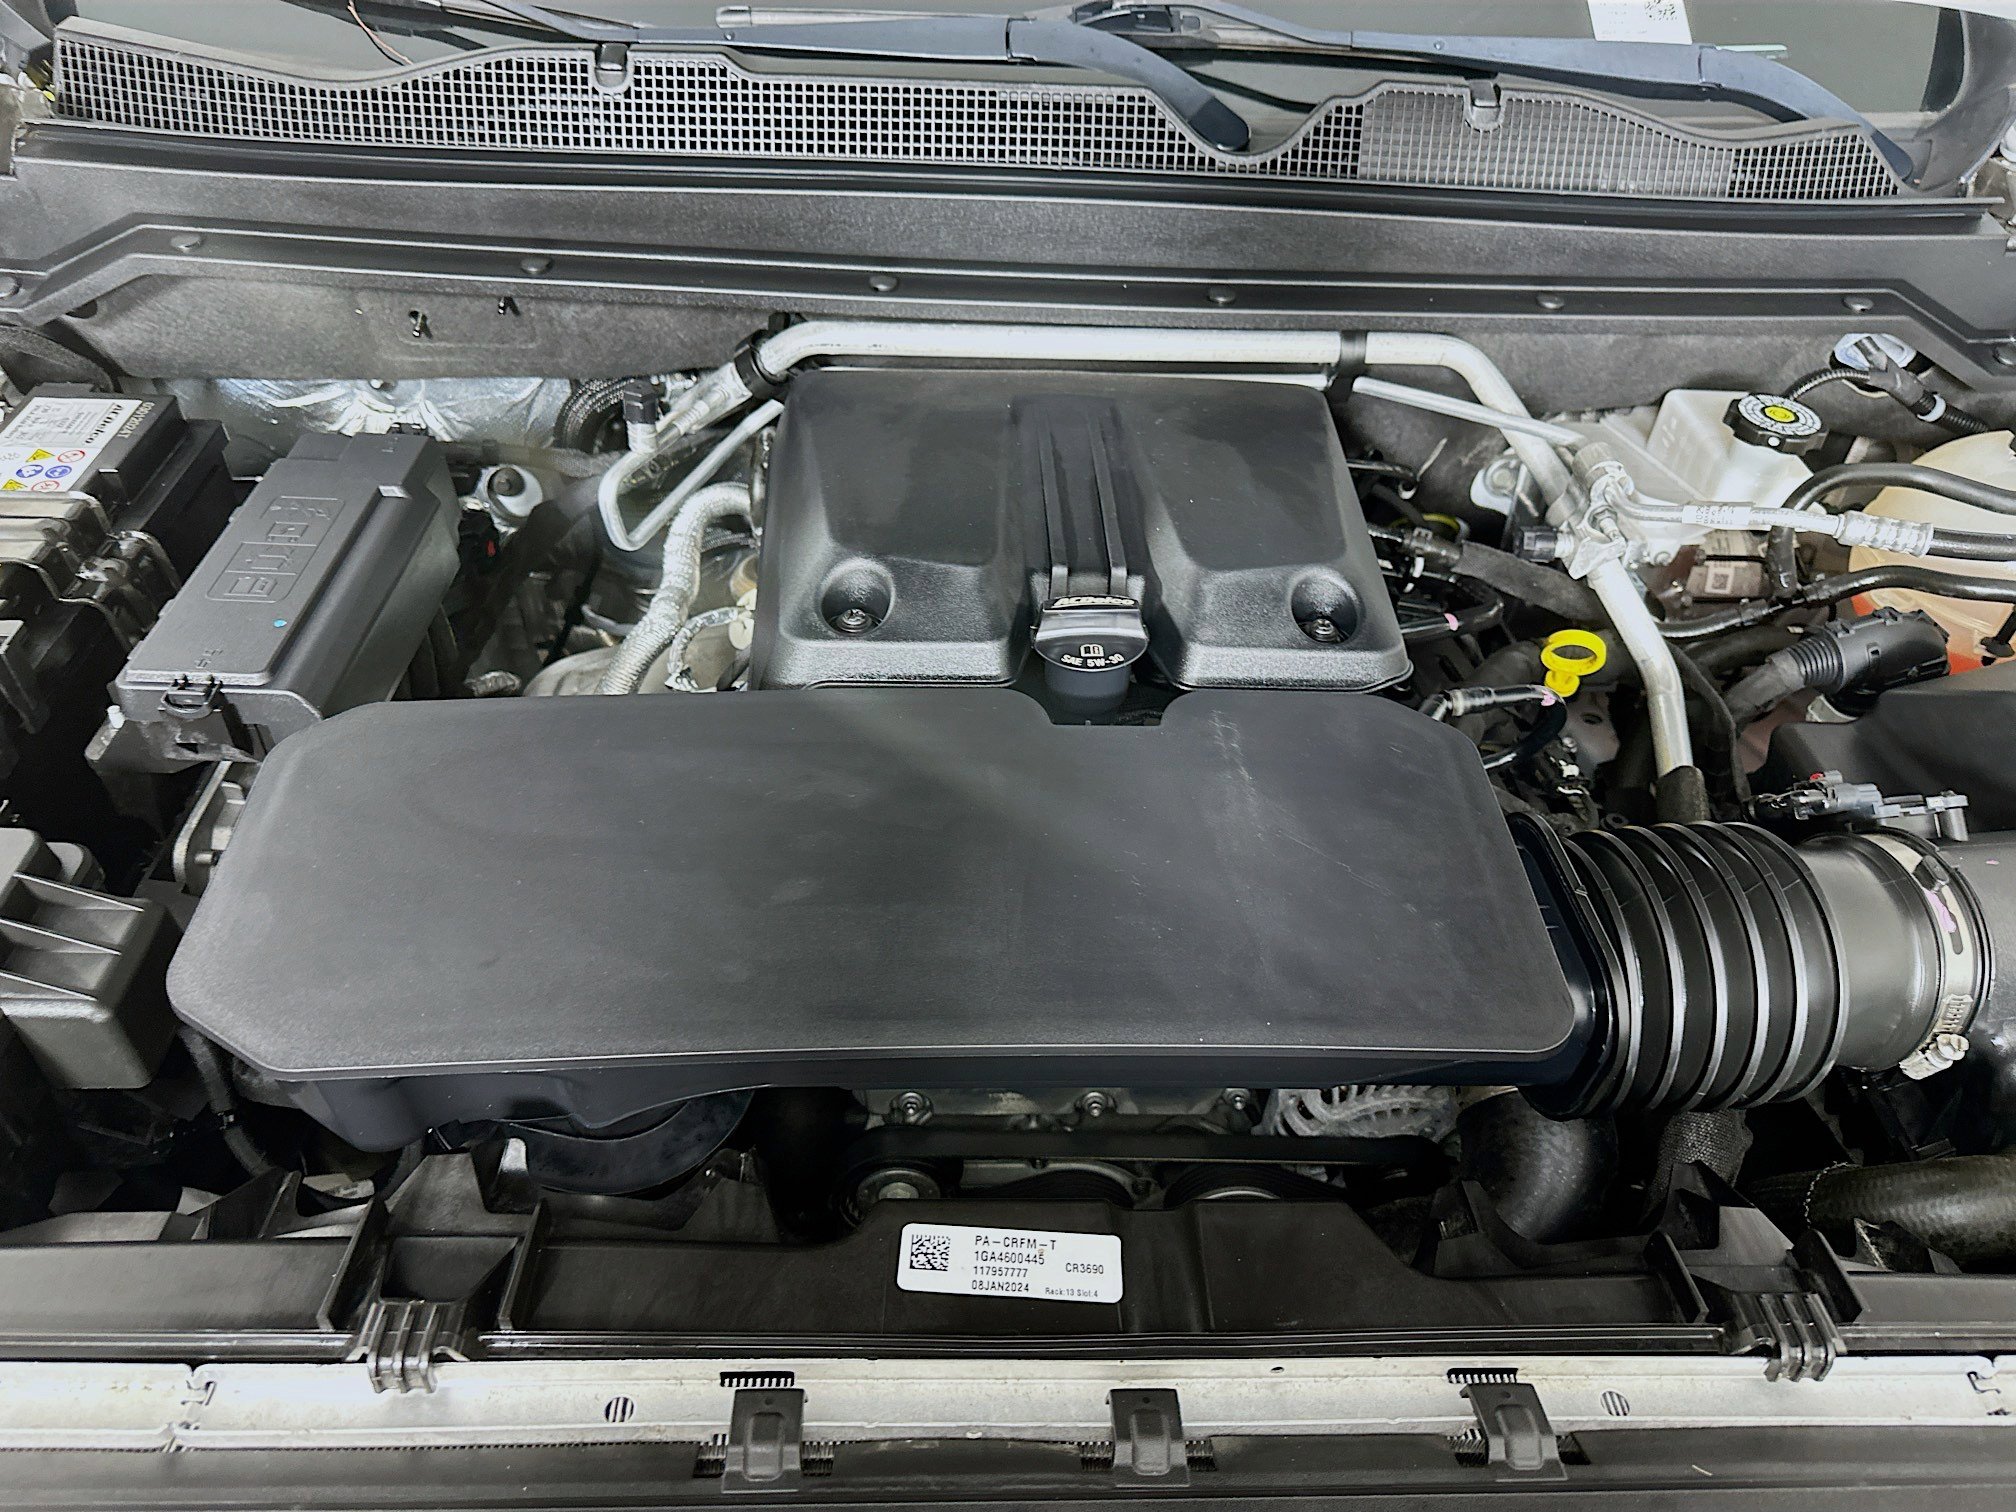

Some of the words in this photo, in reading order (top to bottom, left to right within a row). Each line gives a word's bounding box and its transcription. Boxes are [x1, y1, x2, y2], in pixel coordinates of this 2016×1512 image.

[85, 404, 123, 444] ACDelco
[1051, 596, 1135, 608] ACDelco
[1061, 654, 1084, 666] SAE
[1086, 653, 1125, 667] 5W-30
[974, 1250, 1045, 1265] 1GA4600445
[973, 1266, 1028, 1278] 117957777
[1065, 1262, 1104, 1275] CR3690
[971, 1279, 1030, 1292] 08JAN2024
